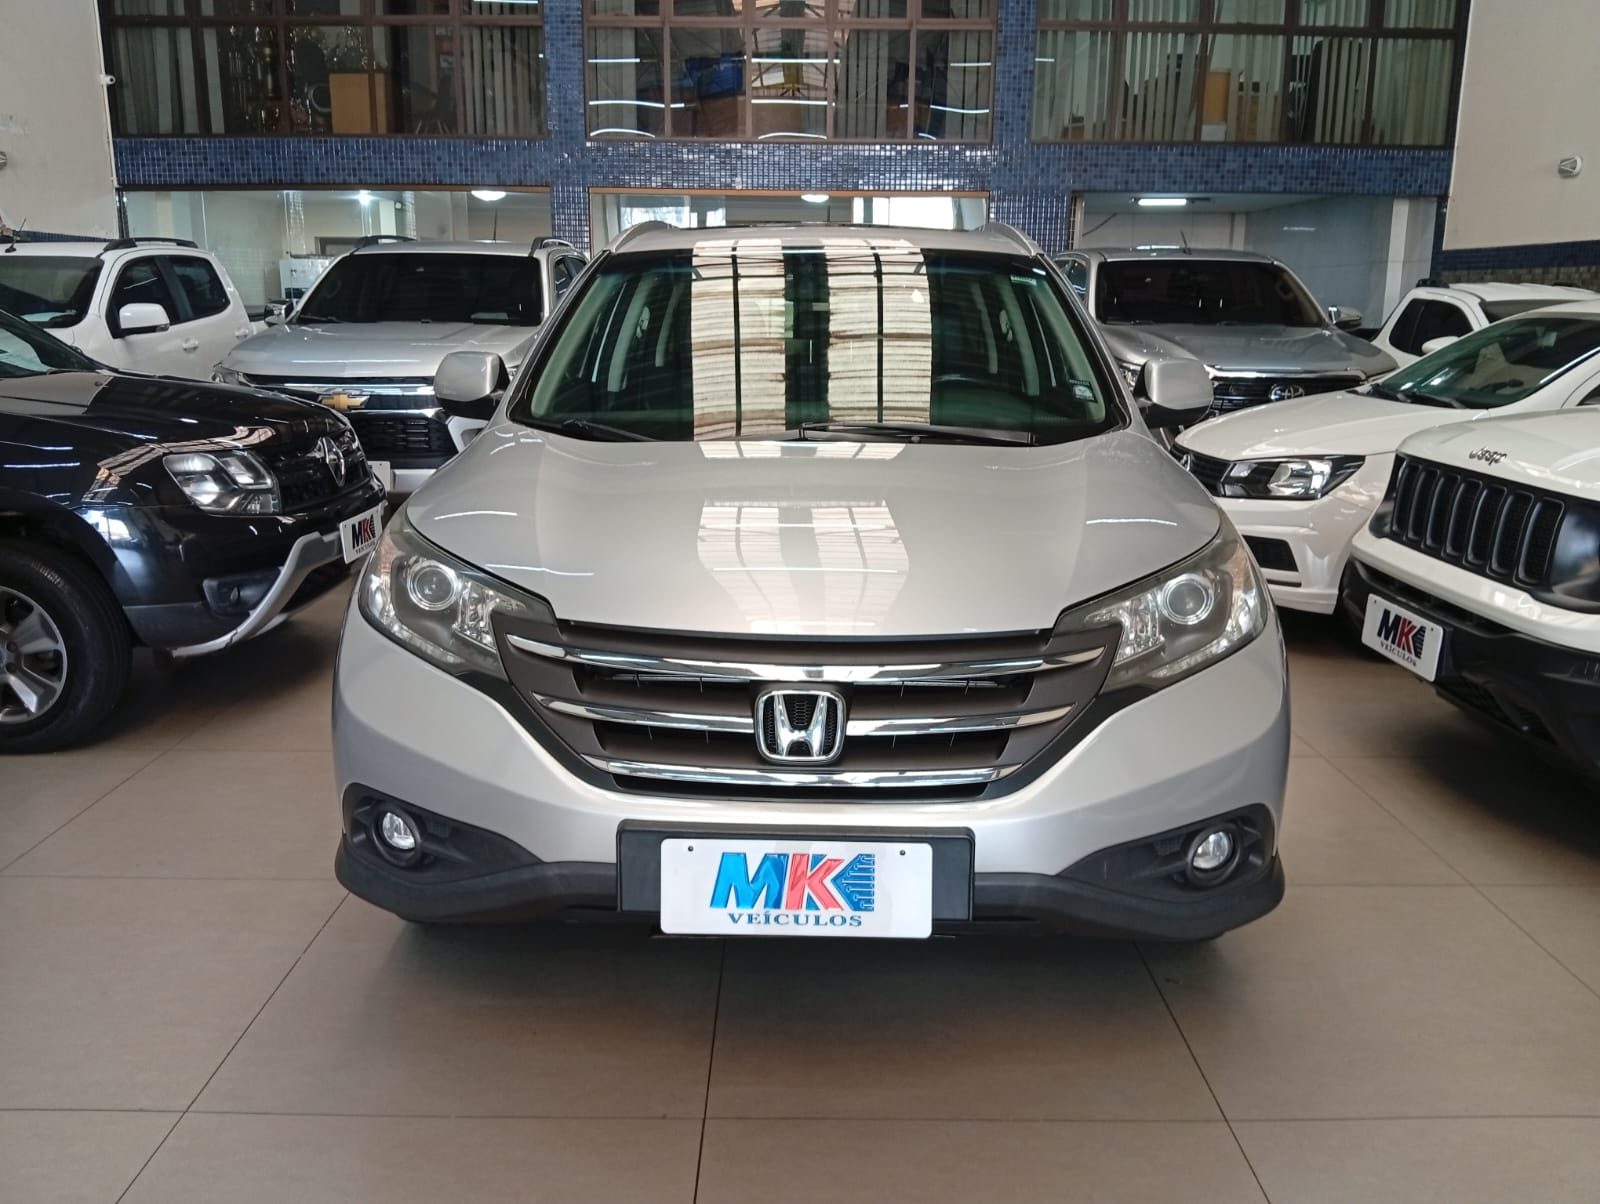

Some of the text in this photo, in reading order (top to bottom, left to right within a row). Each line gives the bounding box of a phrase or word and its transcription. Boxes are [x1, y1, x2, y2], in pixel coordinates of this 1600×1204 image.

[352, 517, 372, 549] MK
[1377, 608, 1417, 656] MK
[710, 852, 845, 911] MK
[728, 911, 863, 927] VEÍCULOS
